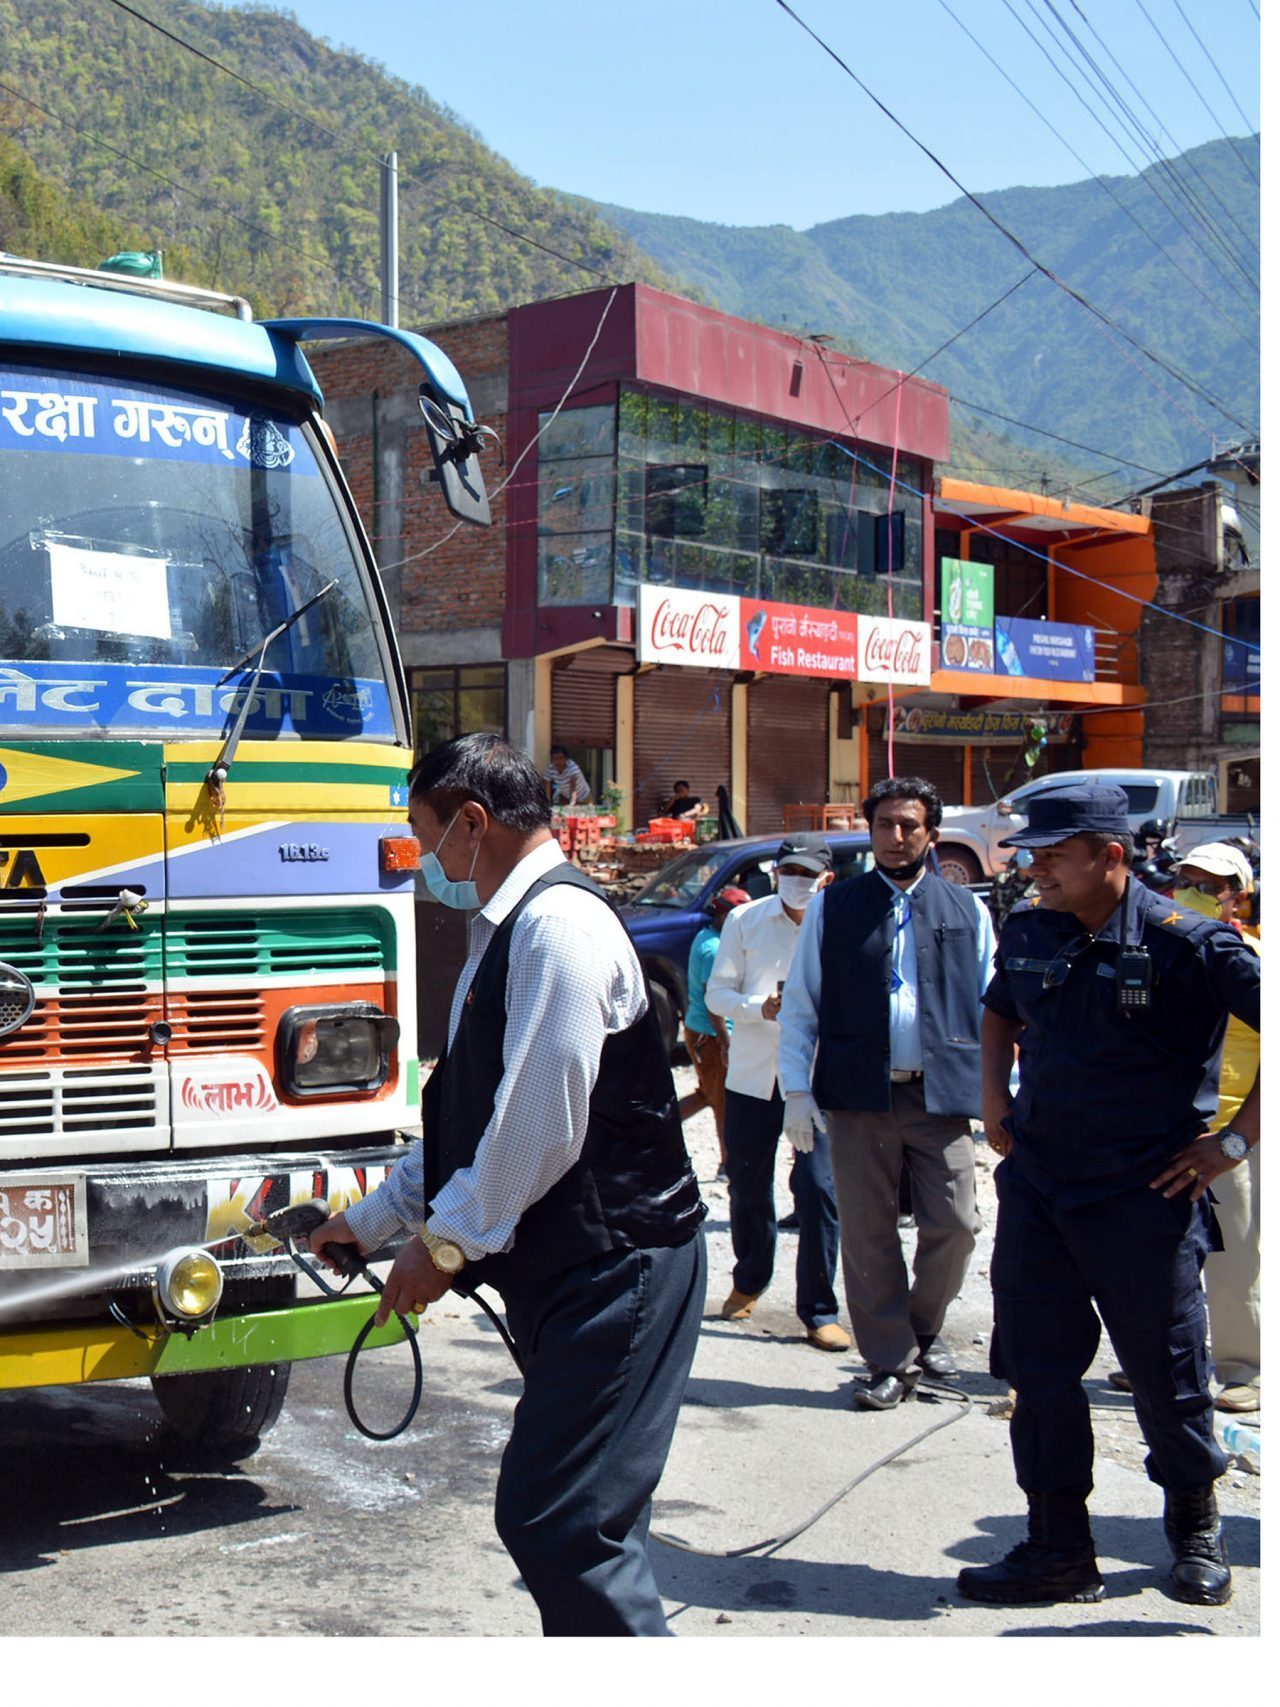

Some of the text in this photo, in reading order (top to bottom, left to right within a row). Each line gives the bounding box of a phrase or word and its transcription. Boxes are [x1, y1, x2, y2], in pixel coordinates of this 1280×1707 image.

[1, 390, 98, 442] रक्षा
[112, 399, 235, 460] गरून्
[770, 645, 855, 673] Fish Restaurant
[126, 681, 313, 721] दाना
[201, 1082, 255, 1117] लाभ
[24, 1189, 52, 1212] क
